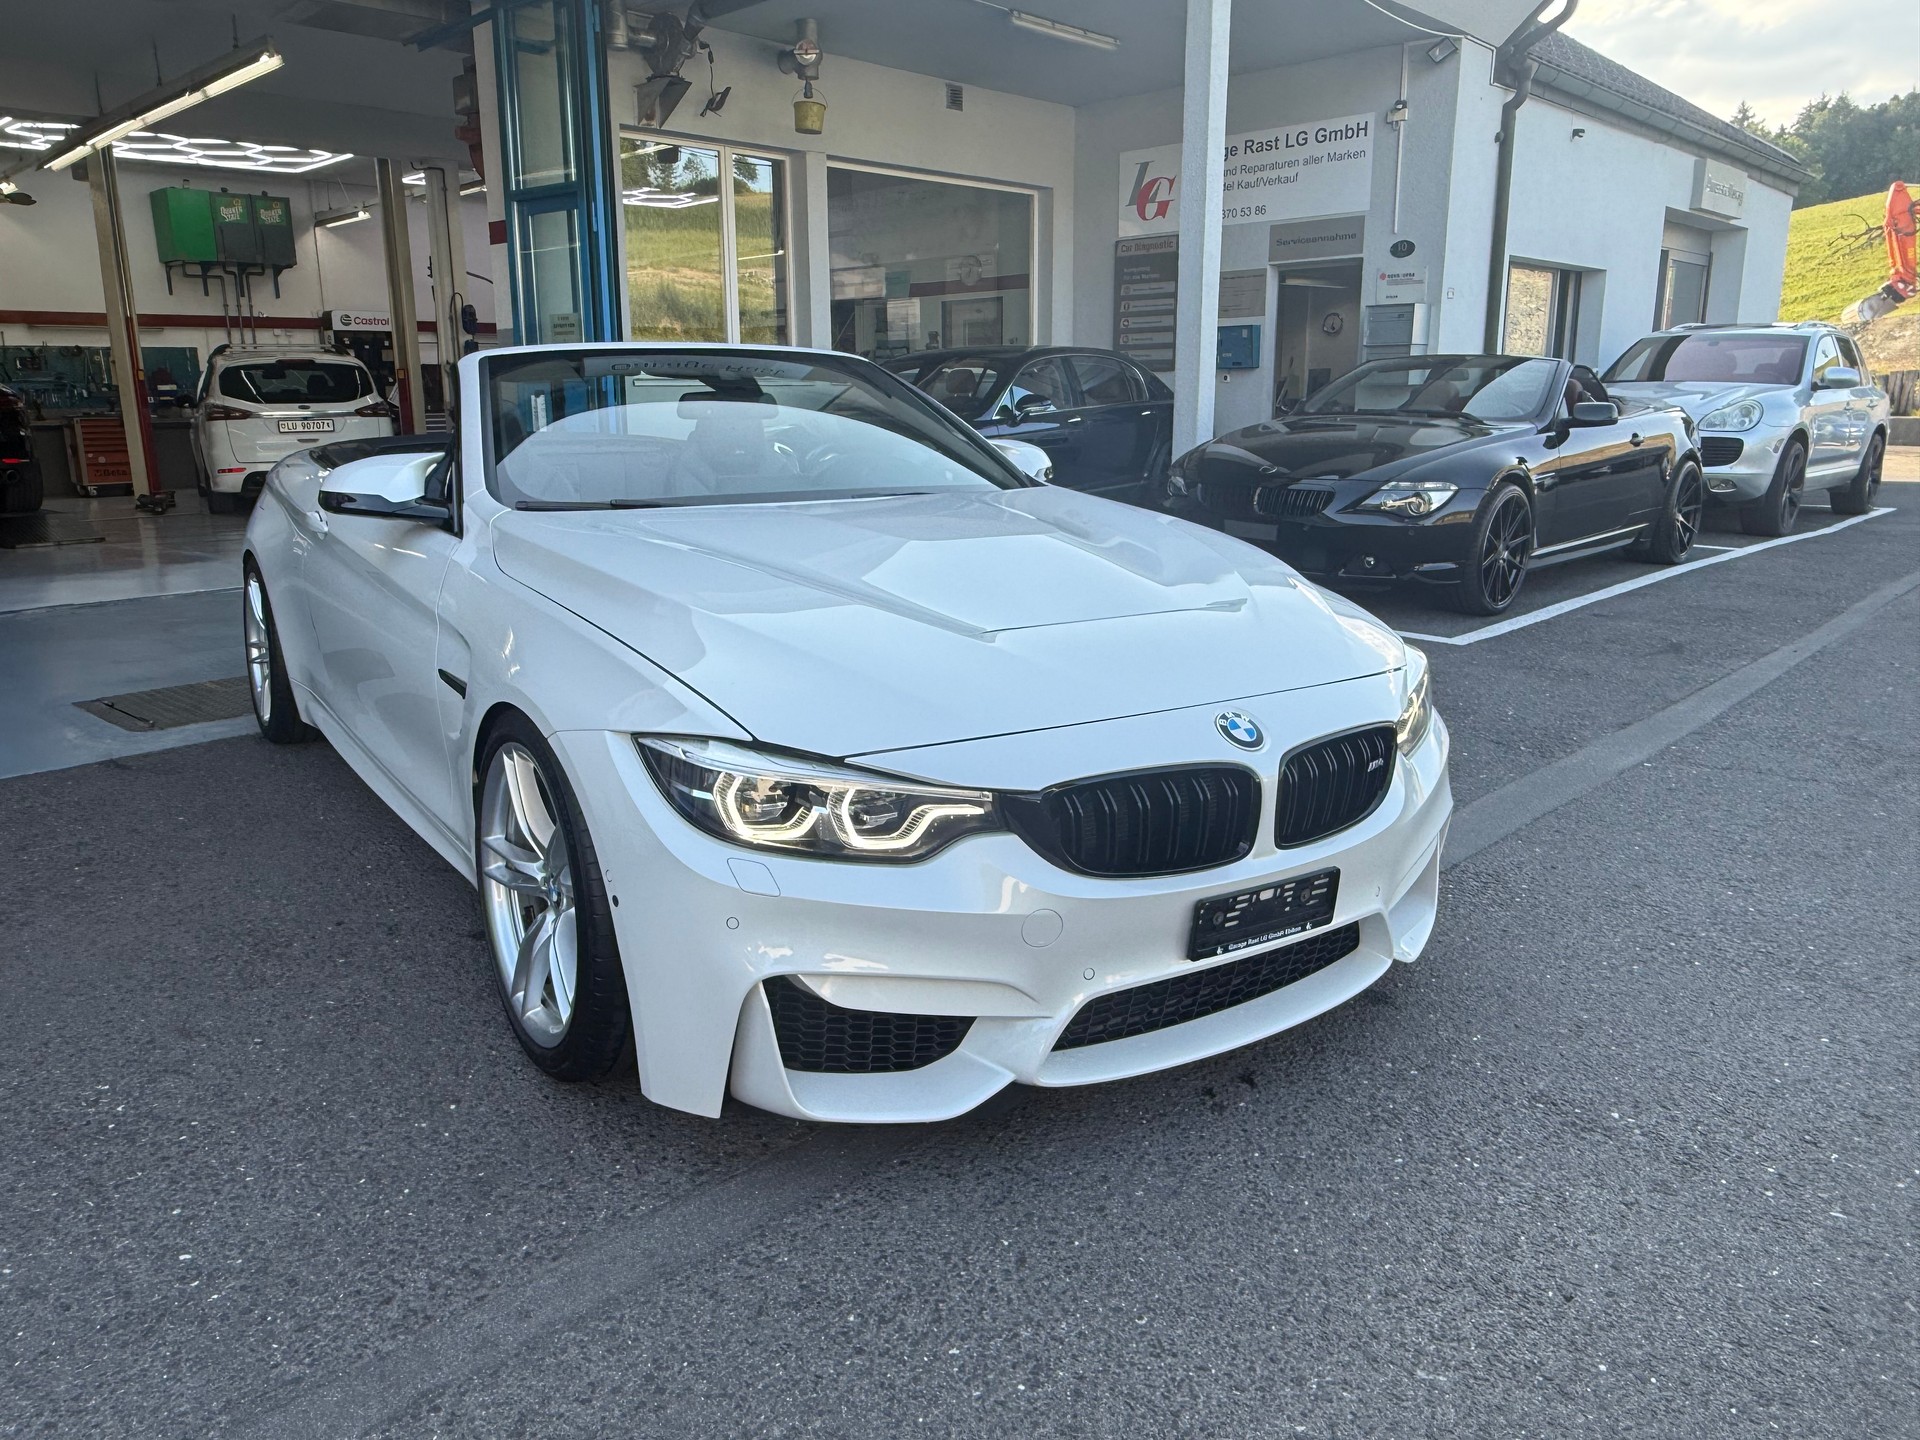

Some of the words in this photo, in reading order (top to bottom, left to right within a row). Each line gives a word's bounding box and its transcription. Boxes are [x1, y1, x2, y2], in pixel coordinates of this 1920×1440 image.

[1244, 136, 1280, 155] Rast
[1285, 129, 1308, 150] LG
[1314, 120, 1368, 145] GmbH
[1240, 158, 1300, 175] Reparaturen
[1303, 154, 1324, 166] aller
[1327, 149, 1366, 163] Marken
[1237, 172, 1299, 190] Kauf/Verkauf
[1240, 207, 1251, 217] 53
[1255, 205, 1267, 215] 86
[1276, 232, 1357, 247] Serviceannahme
[354, 316, 390, 326] Castrol
[287, 421, 297, 431] LU
[302, 421, 326, 431] 90707
